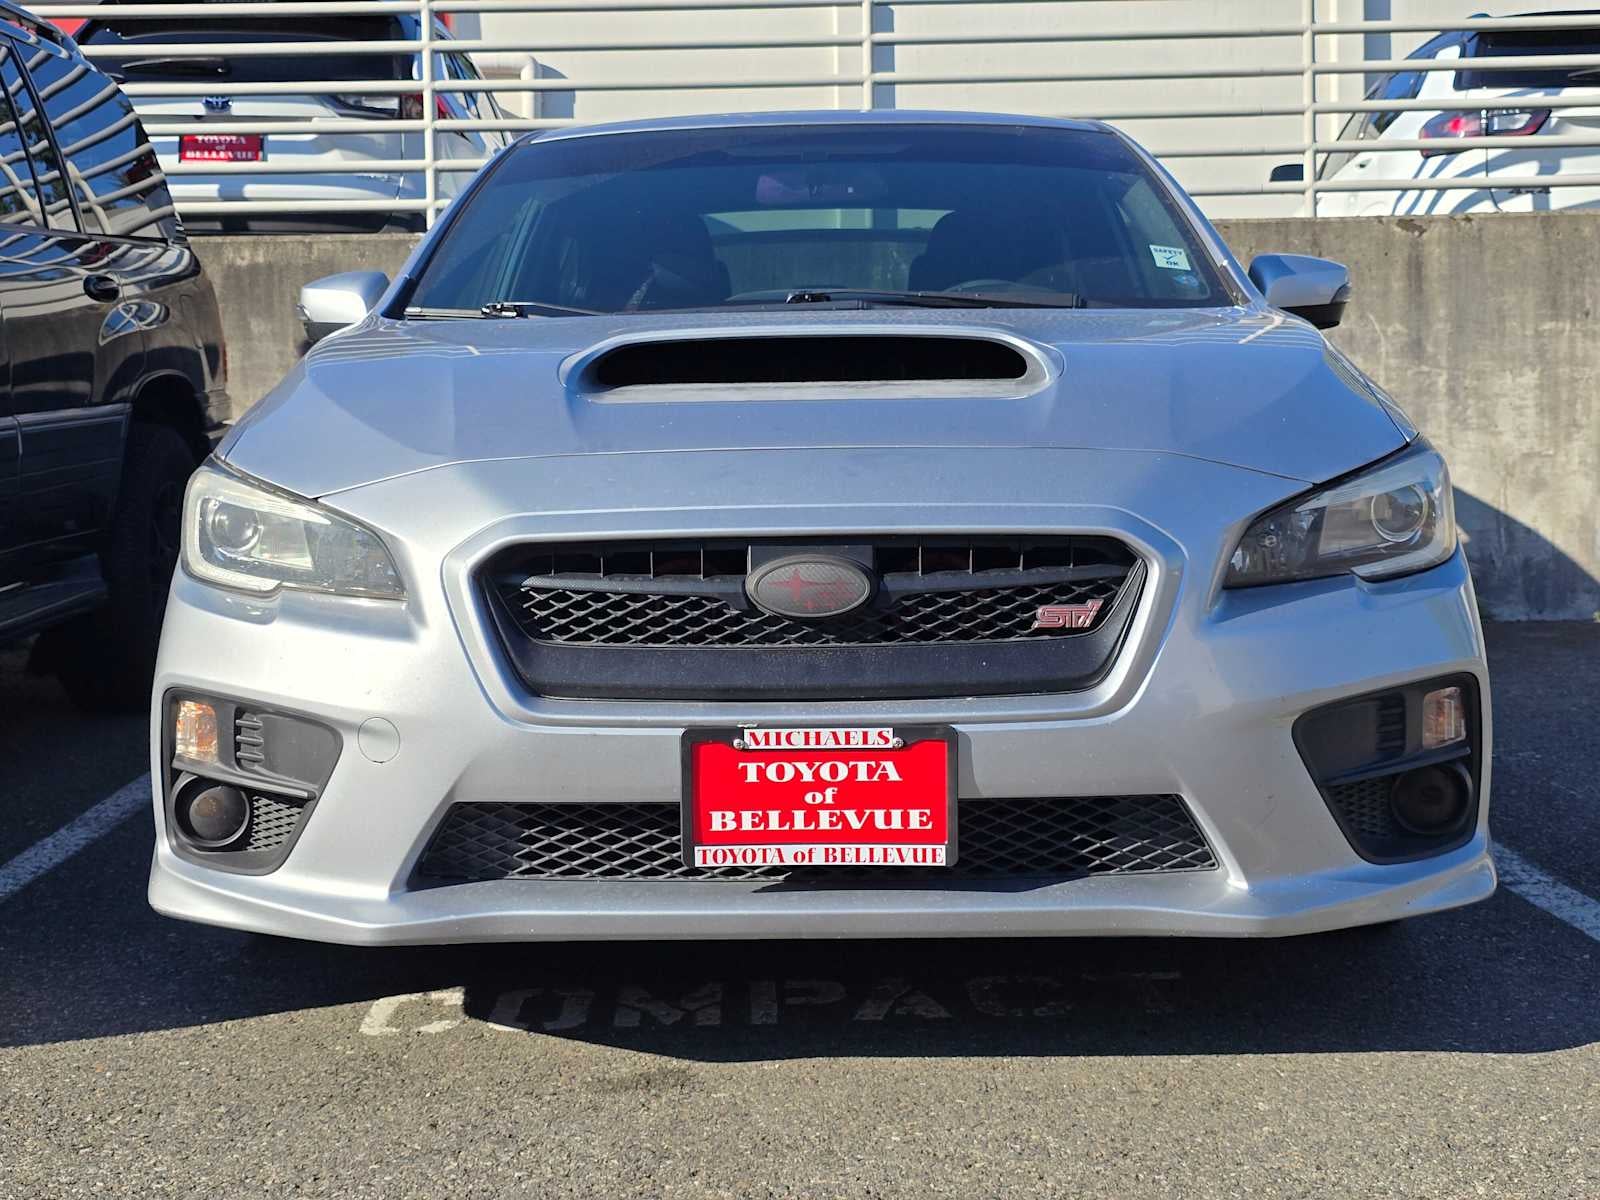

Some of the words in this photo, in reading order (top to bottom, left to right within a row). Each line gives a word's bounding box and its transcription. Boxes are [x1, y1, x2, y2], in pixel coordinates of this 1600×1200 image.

[195, 135, 246, 144] TOYOTA
[185, 151, 255, 159] BELLEVUE
[749, 730, 891, 747] MICHAELS
[738, 760, 903, 783] TOYOTA
[804, 787, 838, 805] of
[709, 808, 933, 832] BELLEVUE
[700, 847, 785, 865] TOYOTA
[793, 847, 817, 865] of
[824, 847, 944, 864] BELLEVUE
